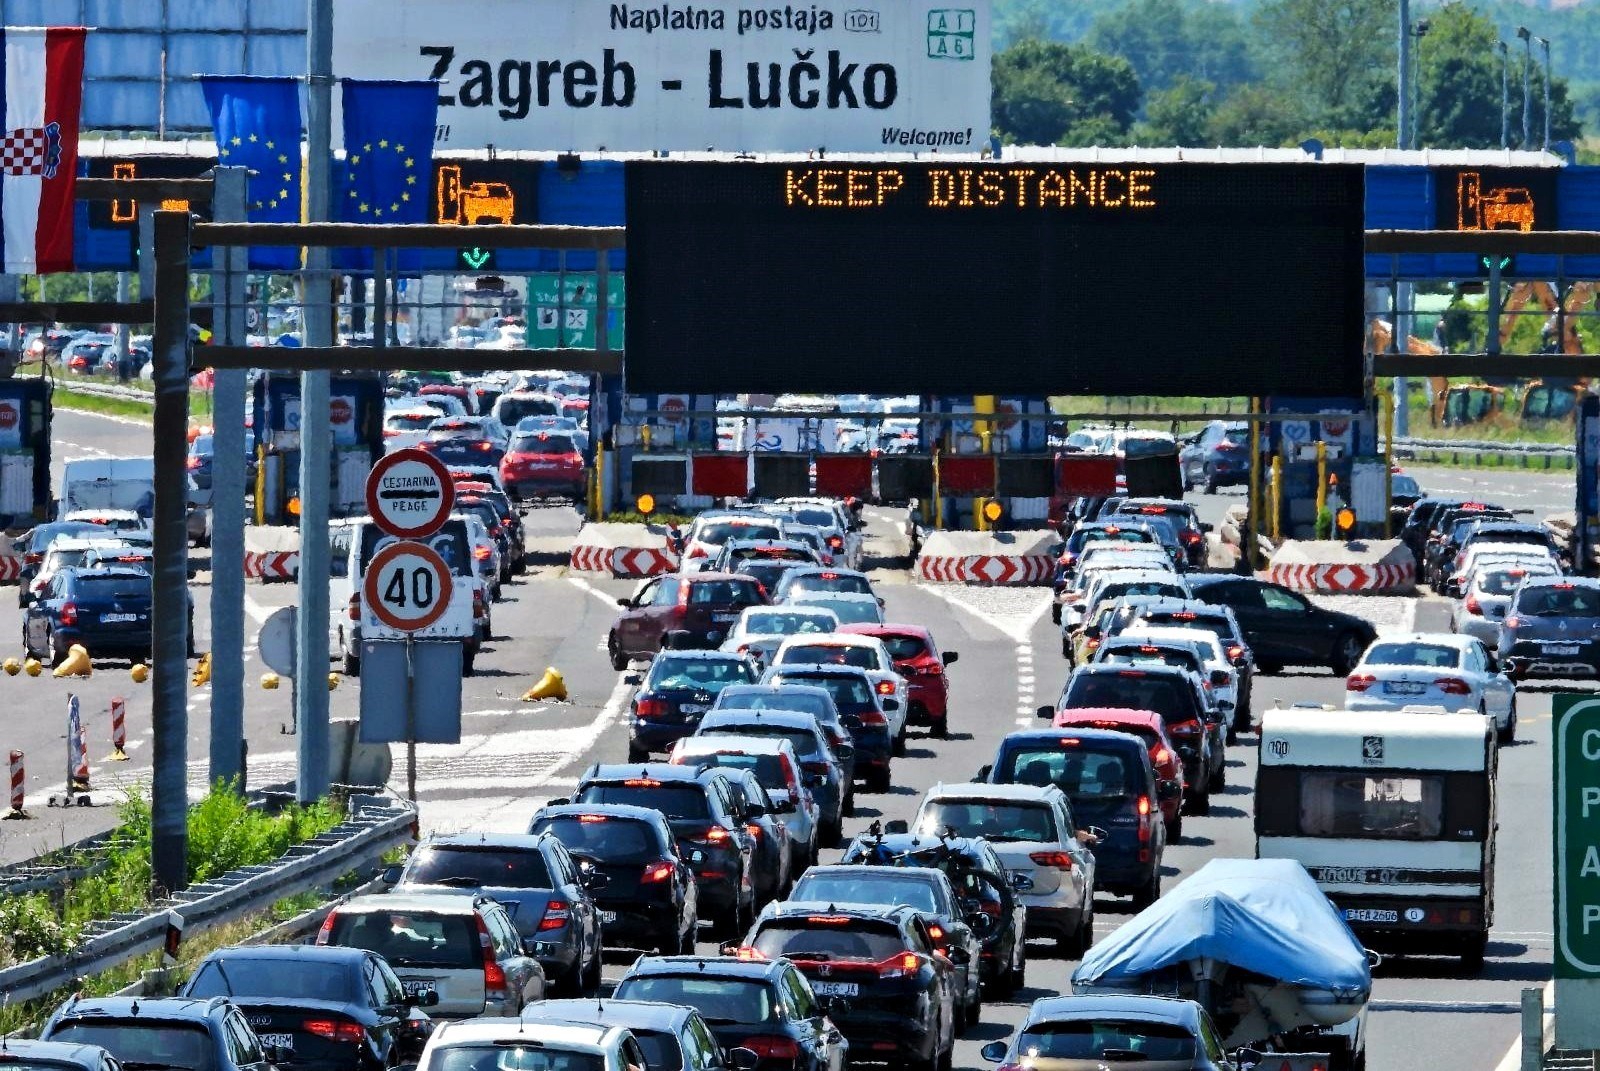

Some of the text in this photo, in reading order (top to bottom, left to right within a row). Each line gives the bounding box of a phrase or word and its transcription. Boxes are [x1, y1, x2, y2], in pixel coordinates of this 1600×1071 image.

[610, 4, 834, 35] Naplatna postaja
[850, 15, 876, 28] 101
[420, 46, 636, 120] Zagreb
[708, 48, 897, 109] Lučko
[881, 127, 972, 146] Welcome!
[786, 169, 1156, 206] KEEP DISTANCE
[383, 476, 436, 489] CESTARINA
[392, 501, 428, 511] PEAGE
[384, 567, 433, 609] 40
